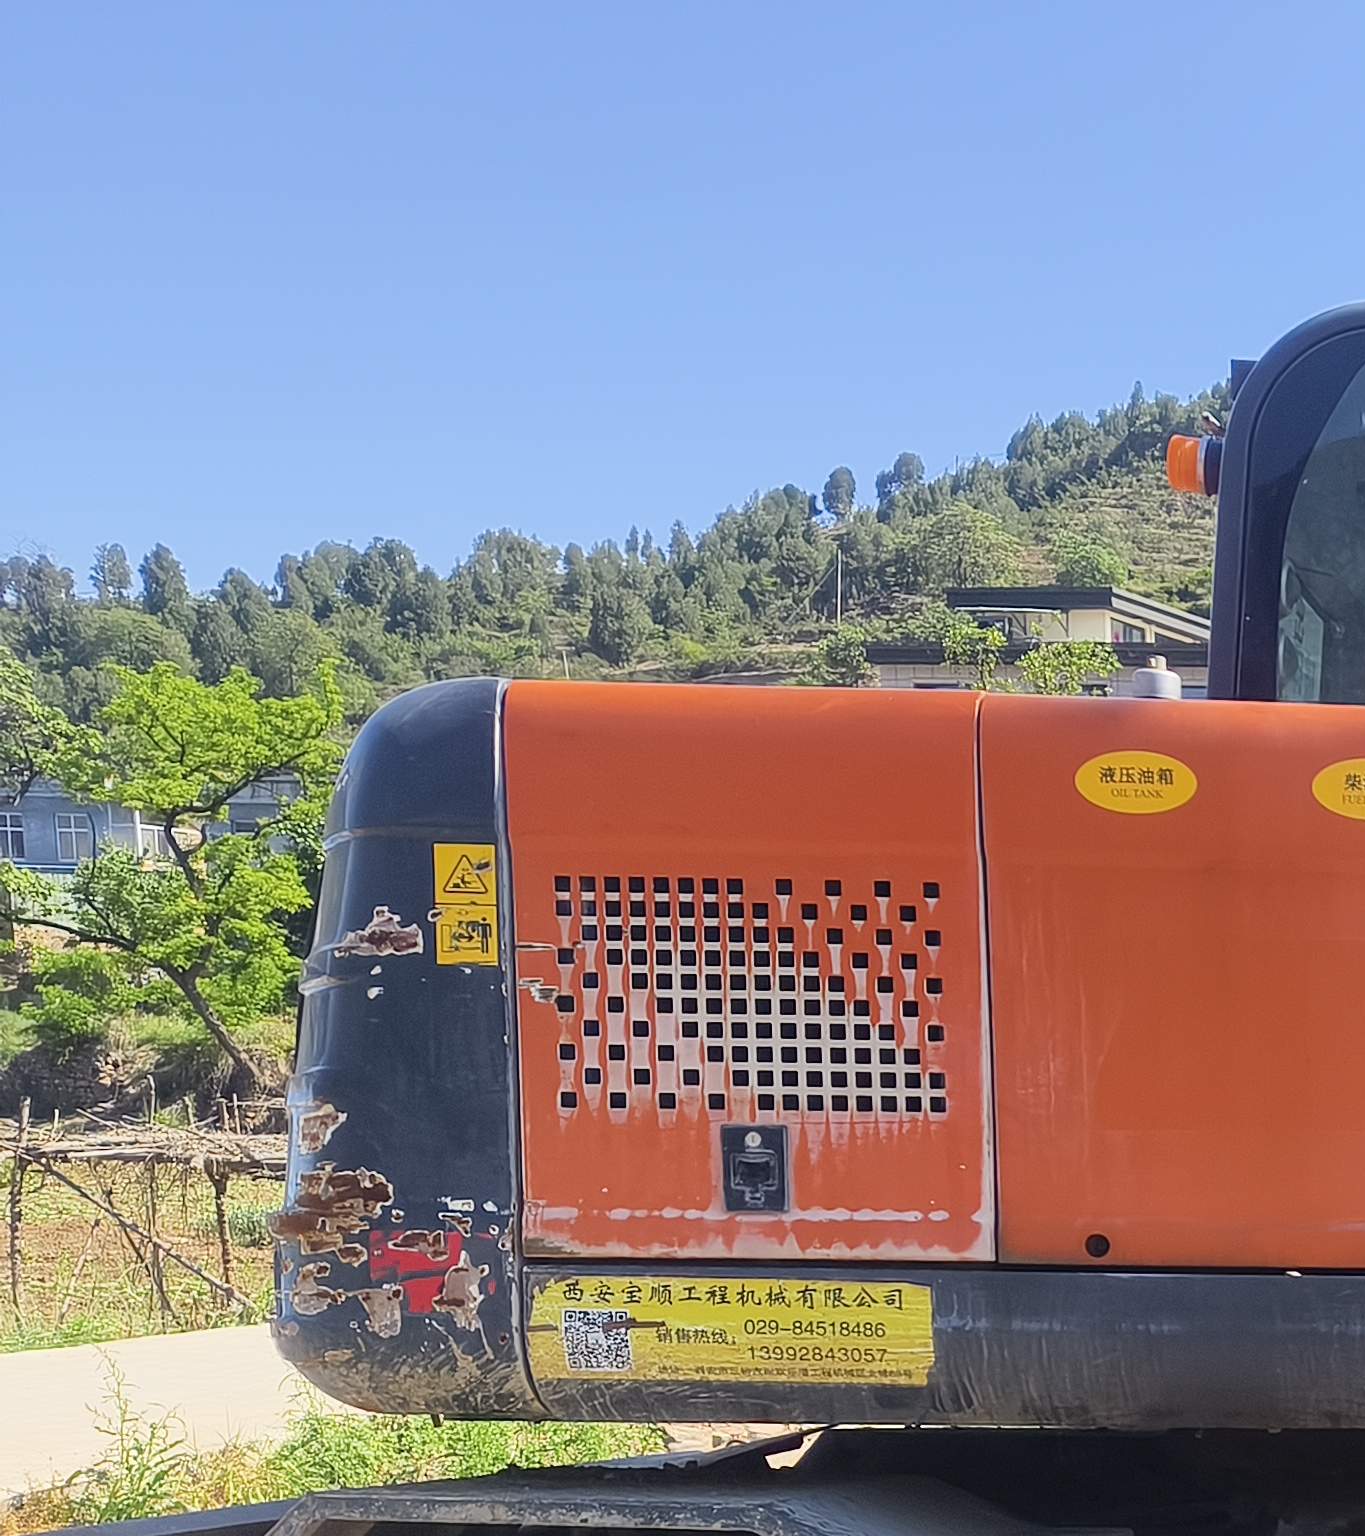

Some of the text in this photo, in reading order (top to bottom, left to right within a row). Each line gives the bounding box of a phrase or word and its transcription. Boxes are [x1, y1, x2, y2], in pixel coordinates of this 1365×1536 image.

[1098, 766, 1175, 785] 液压油箱
[1110, 787, 1164, 800] OIL TANK
[562, 1280, 904, 1311] 西安宝顺工程机械有限公司
[744, 1319, 886, 1338] 029-84518486
[748, 1345, 889, 1363] 13992843057
